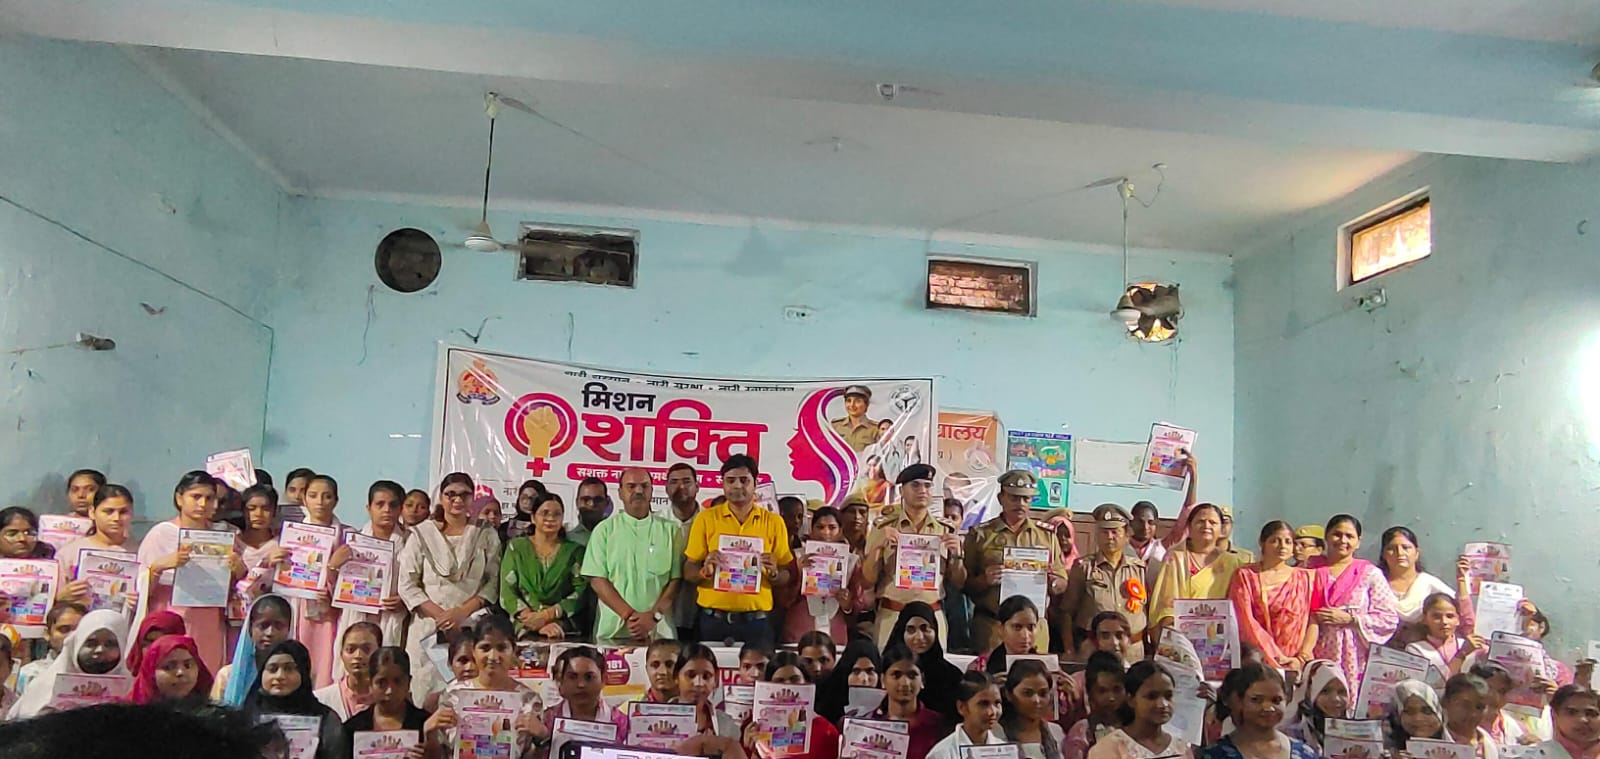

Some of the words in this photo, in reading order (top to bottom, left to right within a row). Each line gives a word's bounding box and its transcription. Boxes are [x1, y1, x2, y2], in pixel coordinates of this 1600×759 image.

[646, 380, 669, 389] नारी
[581, 382, 656, 412] मिशन
[581, 398, 768, 467] शक्ति
[577, 467, 609, 479] सशक्त
